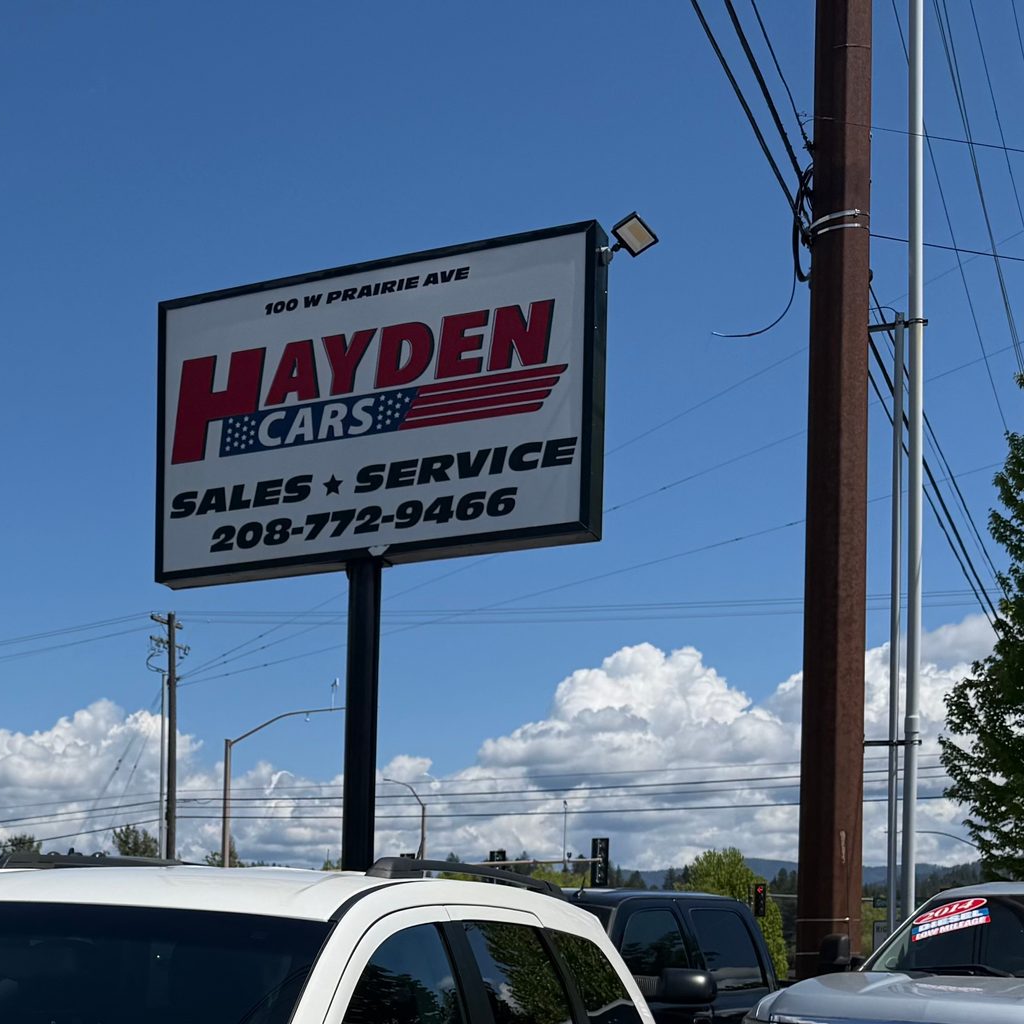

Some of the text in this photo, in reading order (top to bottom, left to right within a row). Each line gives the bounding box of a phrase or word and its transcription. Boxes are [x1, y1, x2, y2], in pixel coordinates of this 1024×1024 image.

[264, 265, 471, 316] 100 W PRAIRIE AVE
[170, 298, 556, 466] HAYDEN
[257, 398, 376, 448] CARS
[170, 436, 578, 519] SALES SERVICE
[209, 487, 519, 553] 208-772-9466
[915, 915, 987, 941] LOW MILEAGE
[917, 909, 984, 932] DIESEL
[923, 899, 976, 920] 2014
